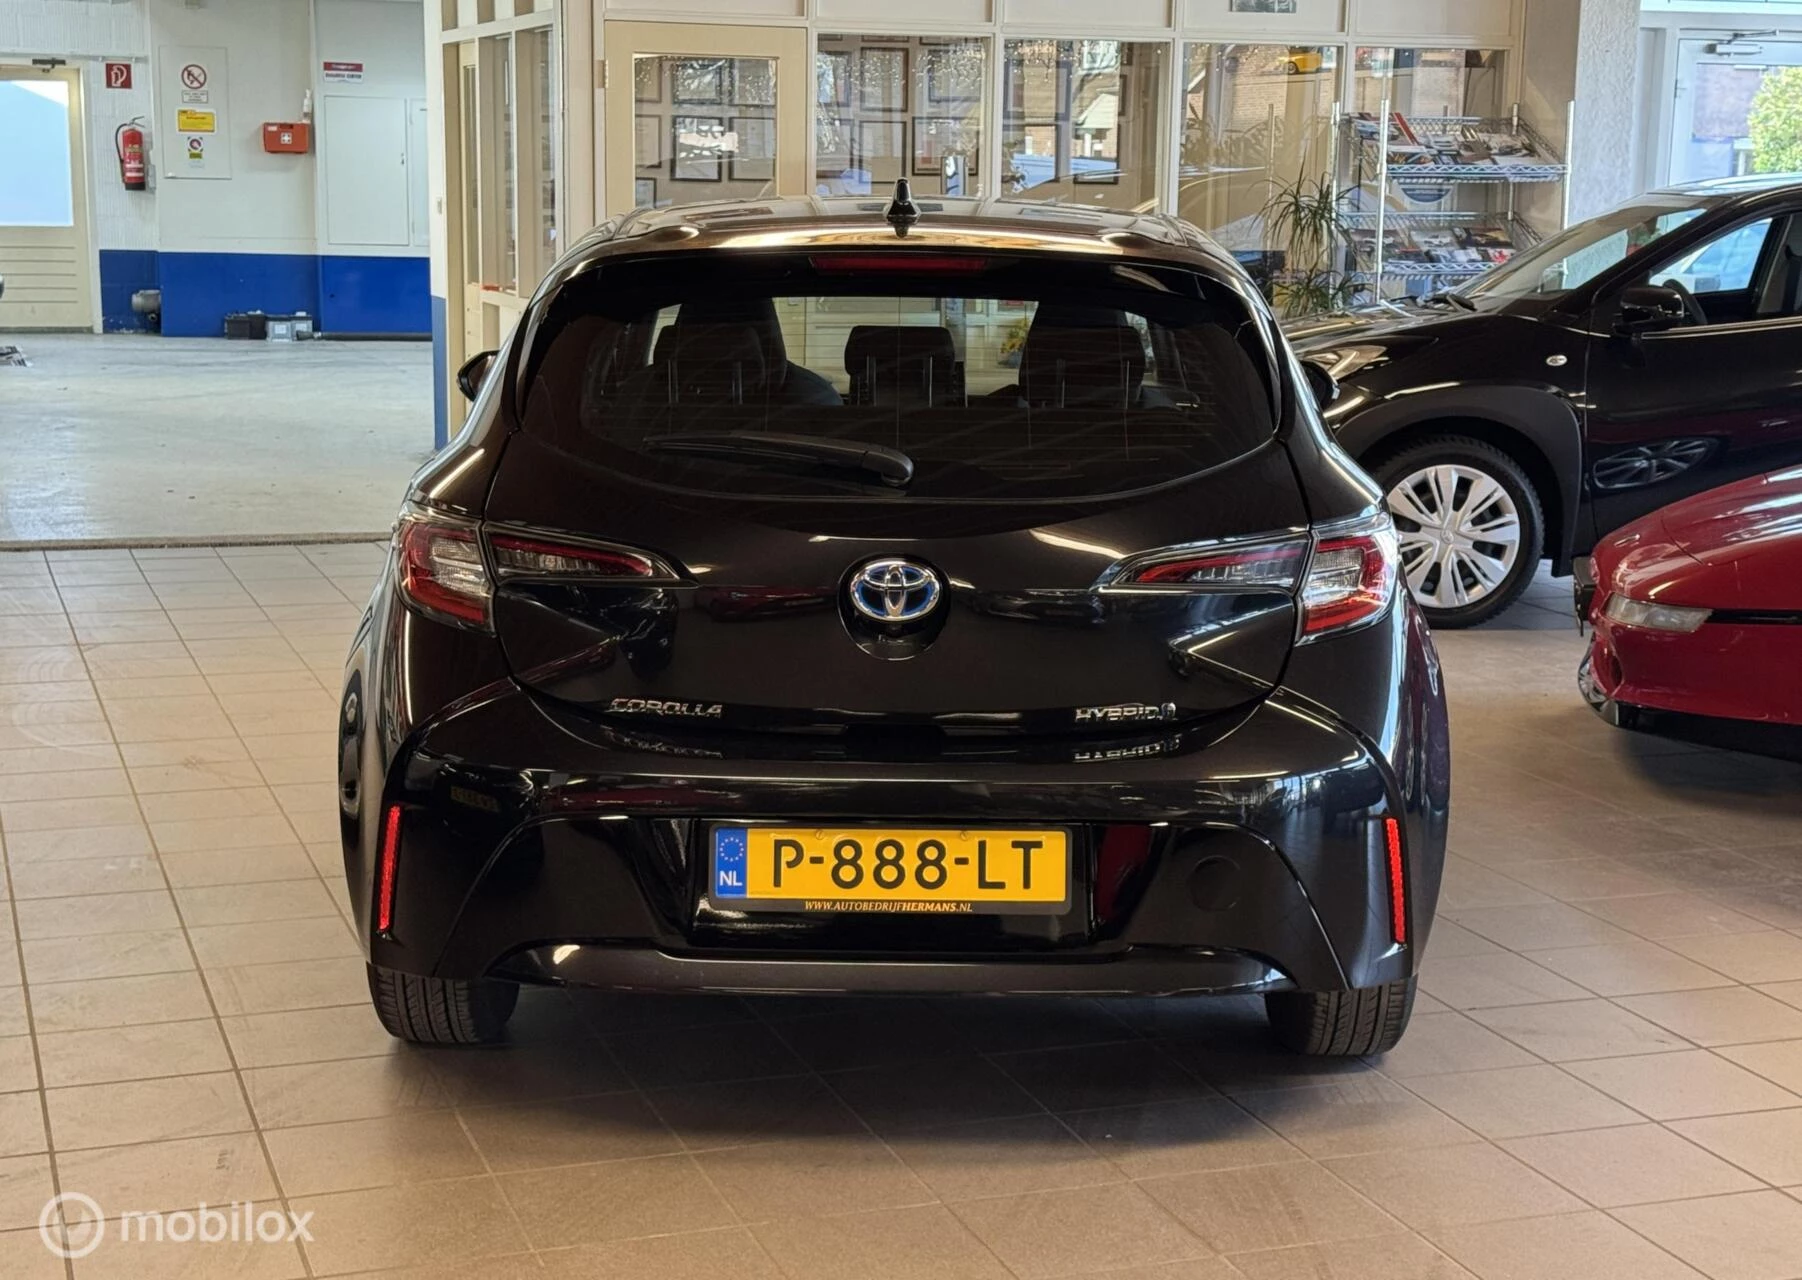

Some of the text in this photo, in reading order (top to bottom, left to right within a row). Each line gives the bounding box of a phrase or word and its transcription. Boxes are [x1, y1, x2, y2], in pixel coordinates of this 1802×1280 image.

[605, 698, 723, 718] COROLLA
[1075, 704, 1162, 721] HYBRID
[773, 838, 1044, 890] P-888-LT
[719, 870, 743, 887] NL
[804, 900, 973, 913] WWW.AUTOBEDRIJFHERMANS.NL
